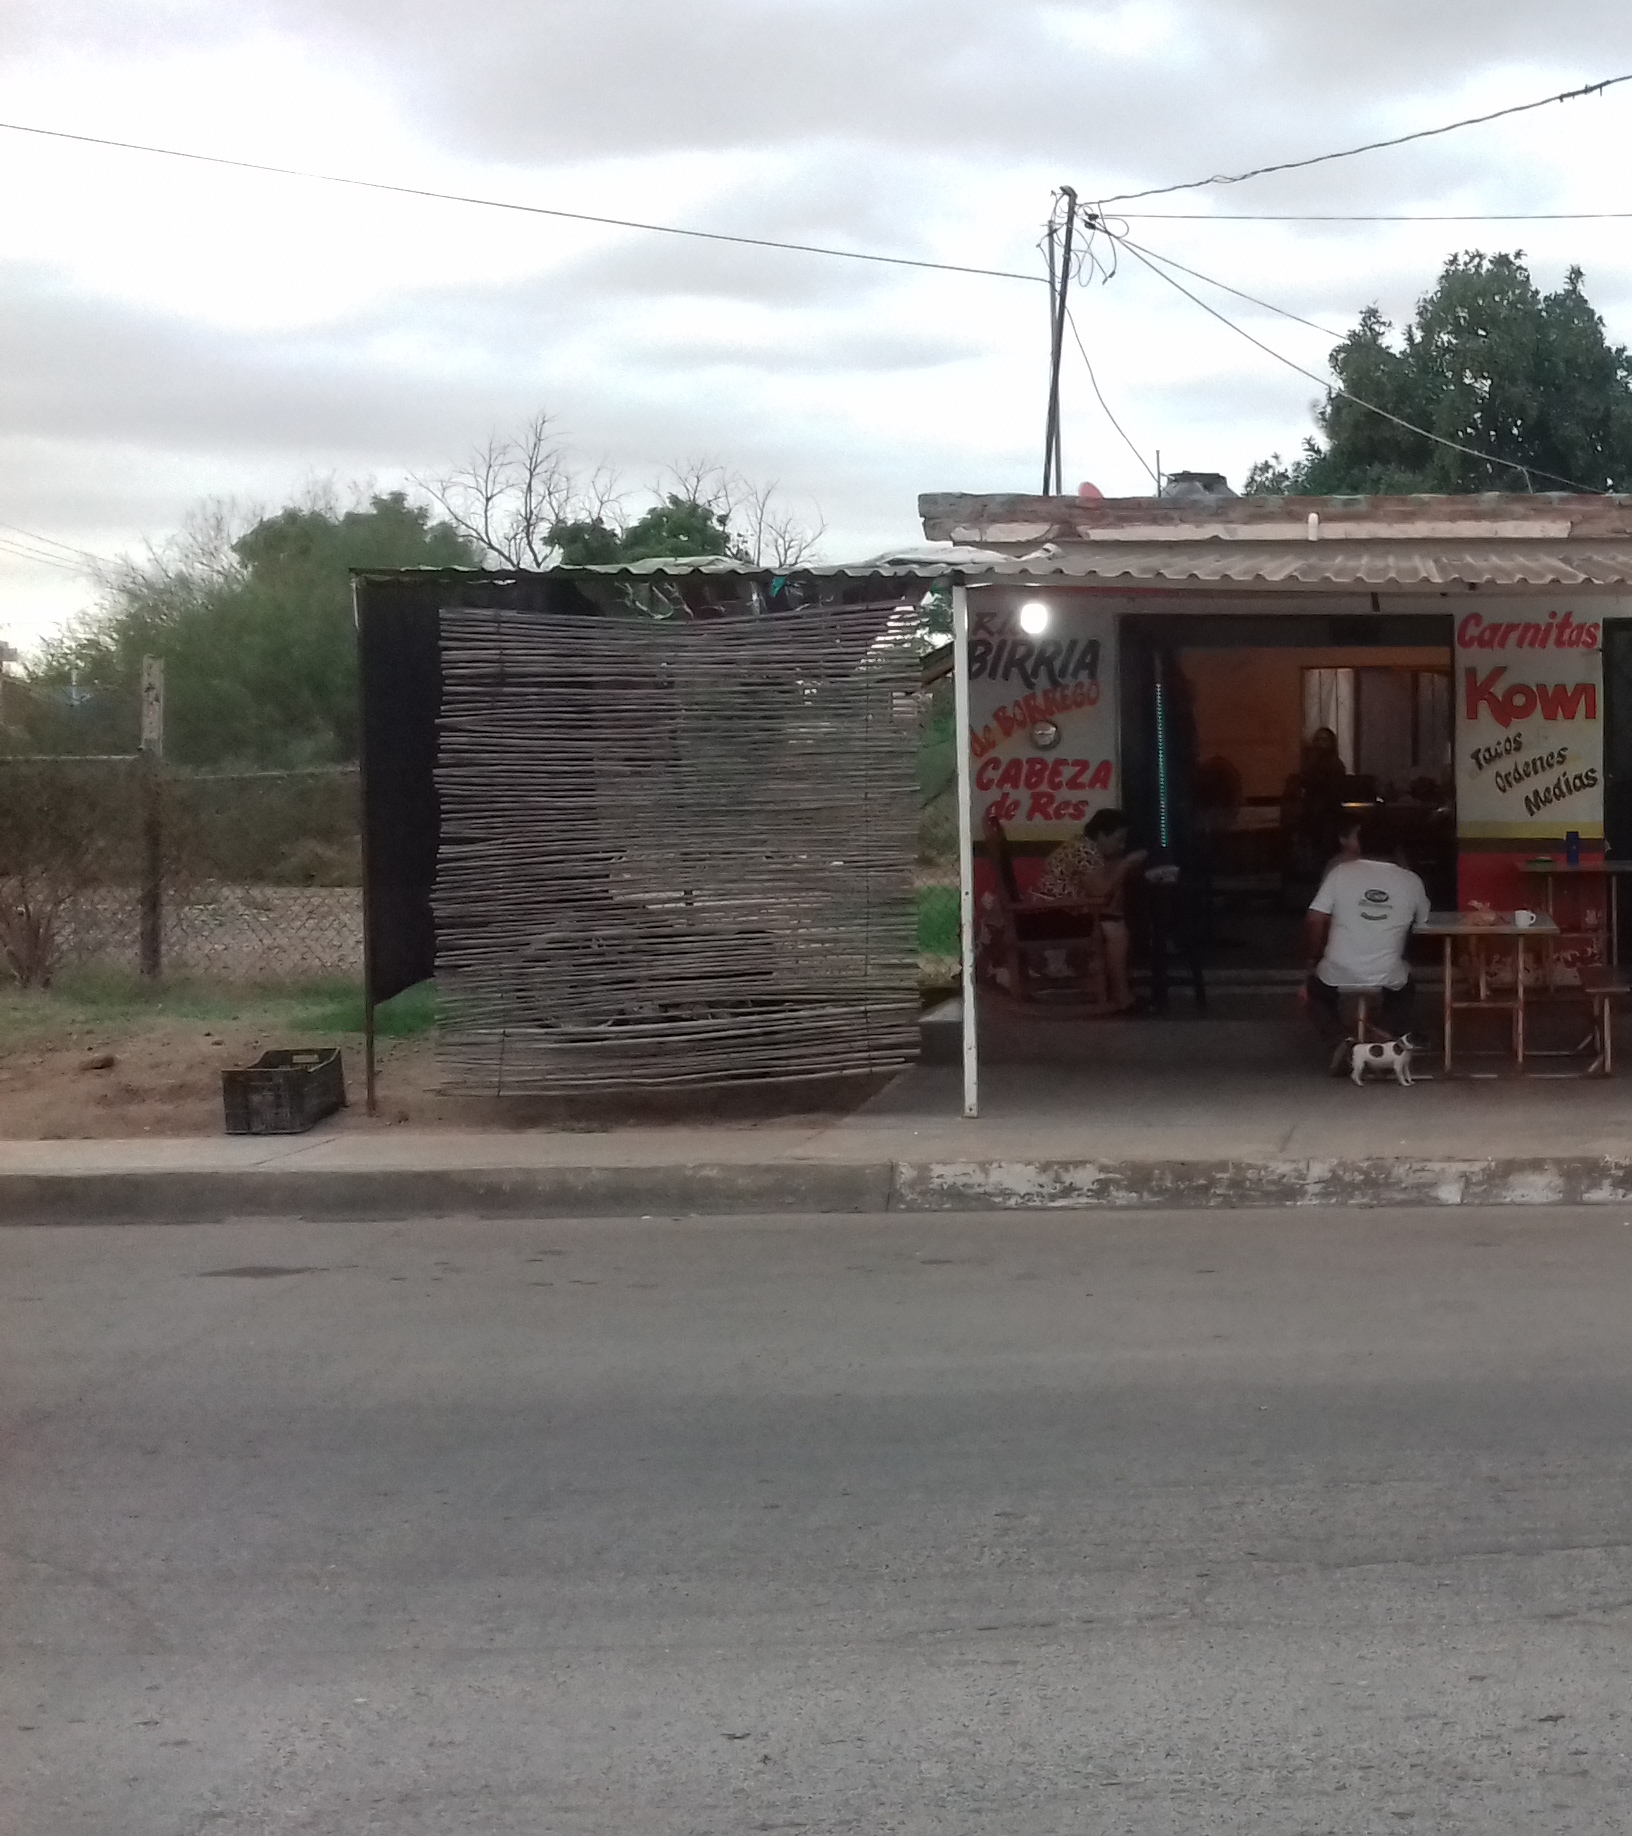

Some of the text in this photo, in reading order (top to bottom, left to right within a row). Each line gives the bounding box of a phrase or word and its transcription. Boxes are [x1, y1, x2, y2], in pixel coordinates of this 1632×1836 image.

[1457, 611, 1601, 648] Carnitas
[968, 638, 1101, 690] BIRRIA
[1470, 732, 1523, 771] Tacos
[1494, 746, 1569, 794] Ordenes
[975, 756, 1113, 791] CABEZA
[1523, 767, 1598, 817] Medias
[984, 791, 1089, 821] de Res
